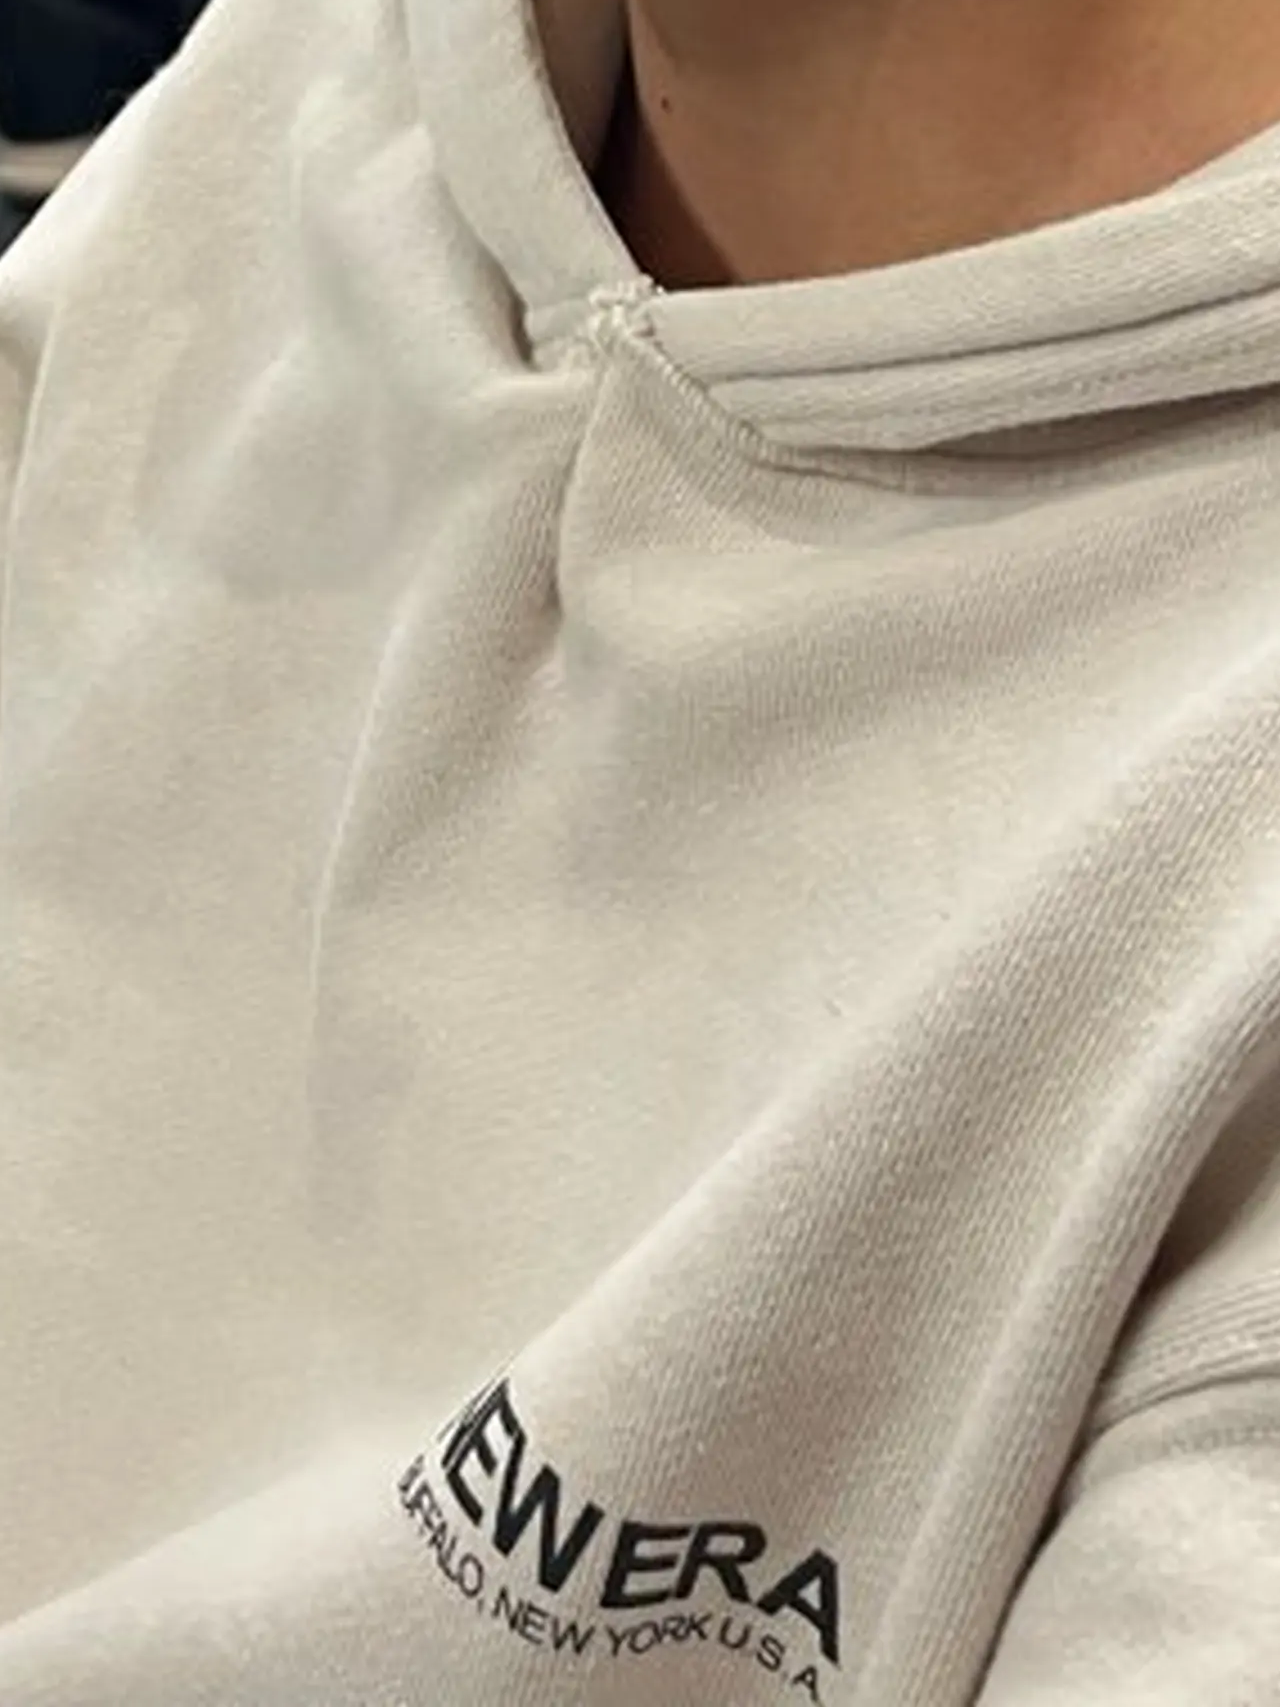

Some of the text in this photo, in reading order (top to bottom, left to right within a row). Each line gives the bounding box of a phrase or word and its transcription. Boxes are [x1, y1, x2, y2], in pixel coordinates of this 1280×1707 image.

[436, 1377, 841, 1665] EW ERA
[491, 1585, 596, 1655] NEW
[606, 1611, 713, 1657] YORK
